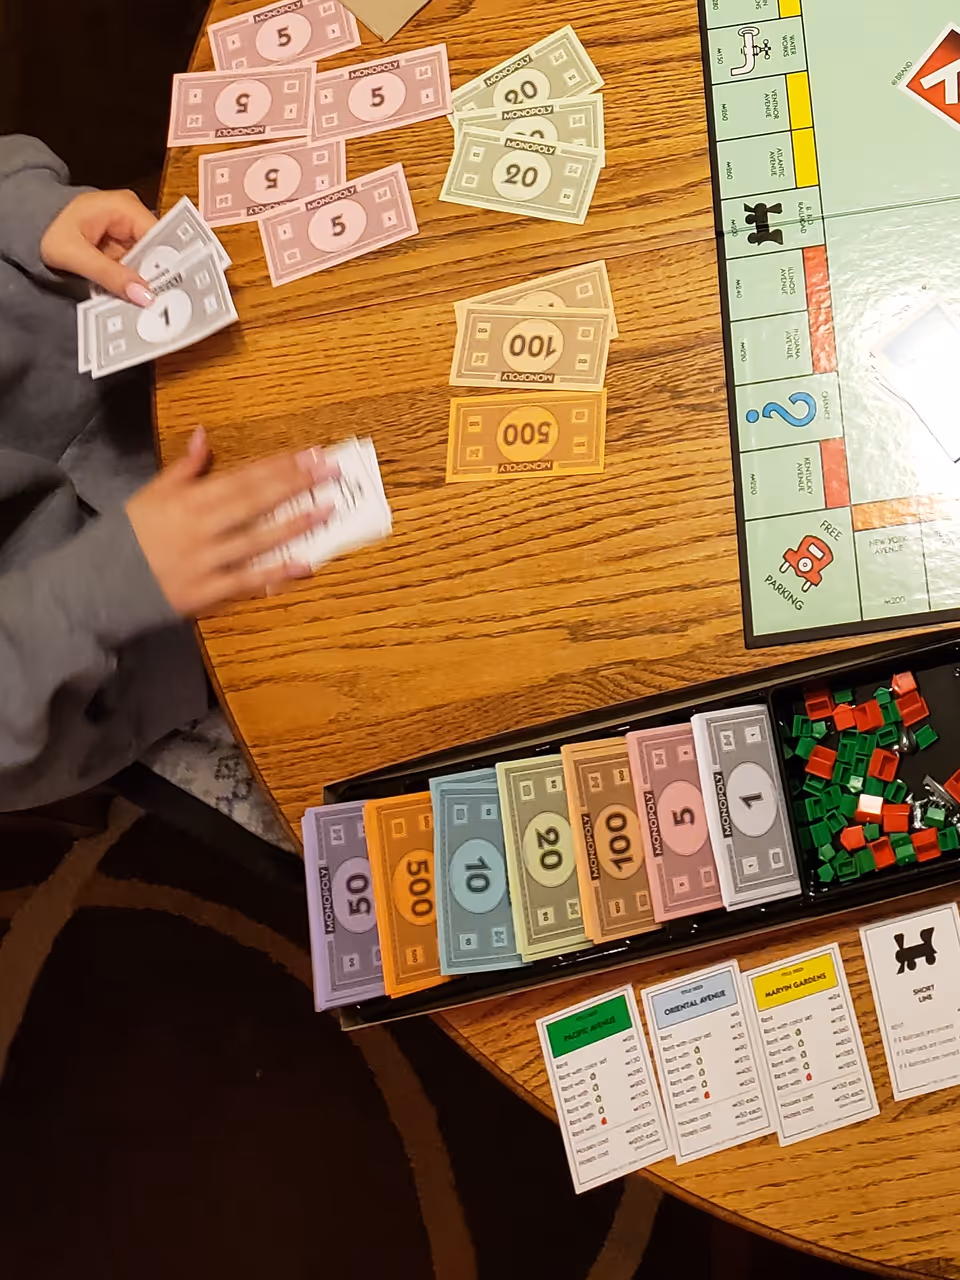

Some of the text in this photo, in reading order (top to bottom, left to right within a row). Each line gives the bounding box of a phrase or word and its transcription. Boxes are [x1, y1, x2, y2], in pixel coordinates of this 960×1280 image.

[254, 0, 303, 23] MONOPOLY
[276, 25, 291, 48] 5
[349, 61, 400, 79] MONOPOLY
[484, 54, 533, 87] MONOPOLY
[235, 93, 251, 114] 5
[370, 86, 385, 107] 5
[504, 80, 538, 104] 20
[771, 89, 780, 120] VENTNOR
[502, 105, 554, 120] MONOPOLY
[215, 125, 265, 138] MONOPOLY
[505, 138, 556, 155] MONOPOLY
[777, 147, 786, 178] ATLANTIC
[264, 168, 280, 189] 5
[503, 164, 538, 188] 20
[305, 186, 357, 212] MONOPOLY
[330, 215, 346, 237] 5
[509, 334, 557, 360] 100
[501, 372, 555, 384] MONOPOLY
[503, 420, 552, 446] 500
[498, 460, 553, 474] MONOPOLY
[804, 456, 814, 495] KENTUCKY
[818, 518, 843, 541] FREE
[764, 574, 805, 611] PARKING
[713, 771, 732, 838] MONOPOLY
[739, 792, 763, 809] 1
[644, 791, 663, 857] MONOPOLY
[671, 807, 695, 827] 5
[535, 827, 563, 871] 20
[581, 812, 599, 881] MONOPOLY
[605, 812, 634, 872] 100
[464, 856, 493, 893] 10
[346, 873, 371, 916] 50
[406, 858, 433, 917] 500
[319, 867, 335, 934] MONOPOLY
